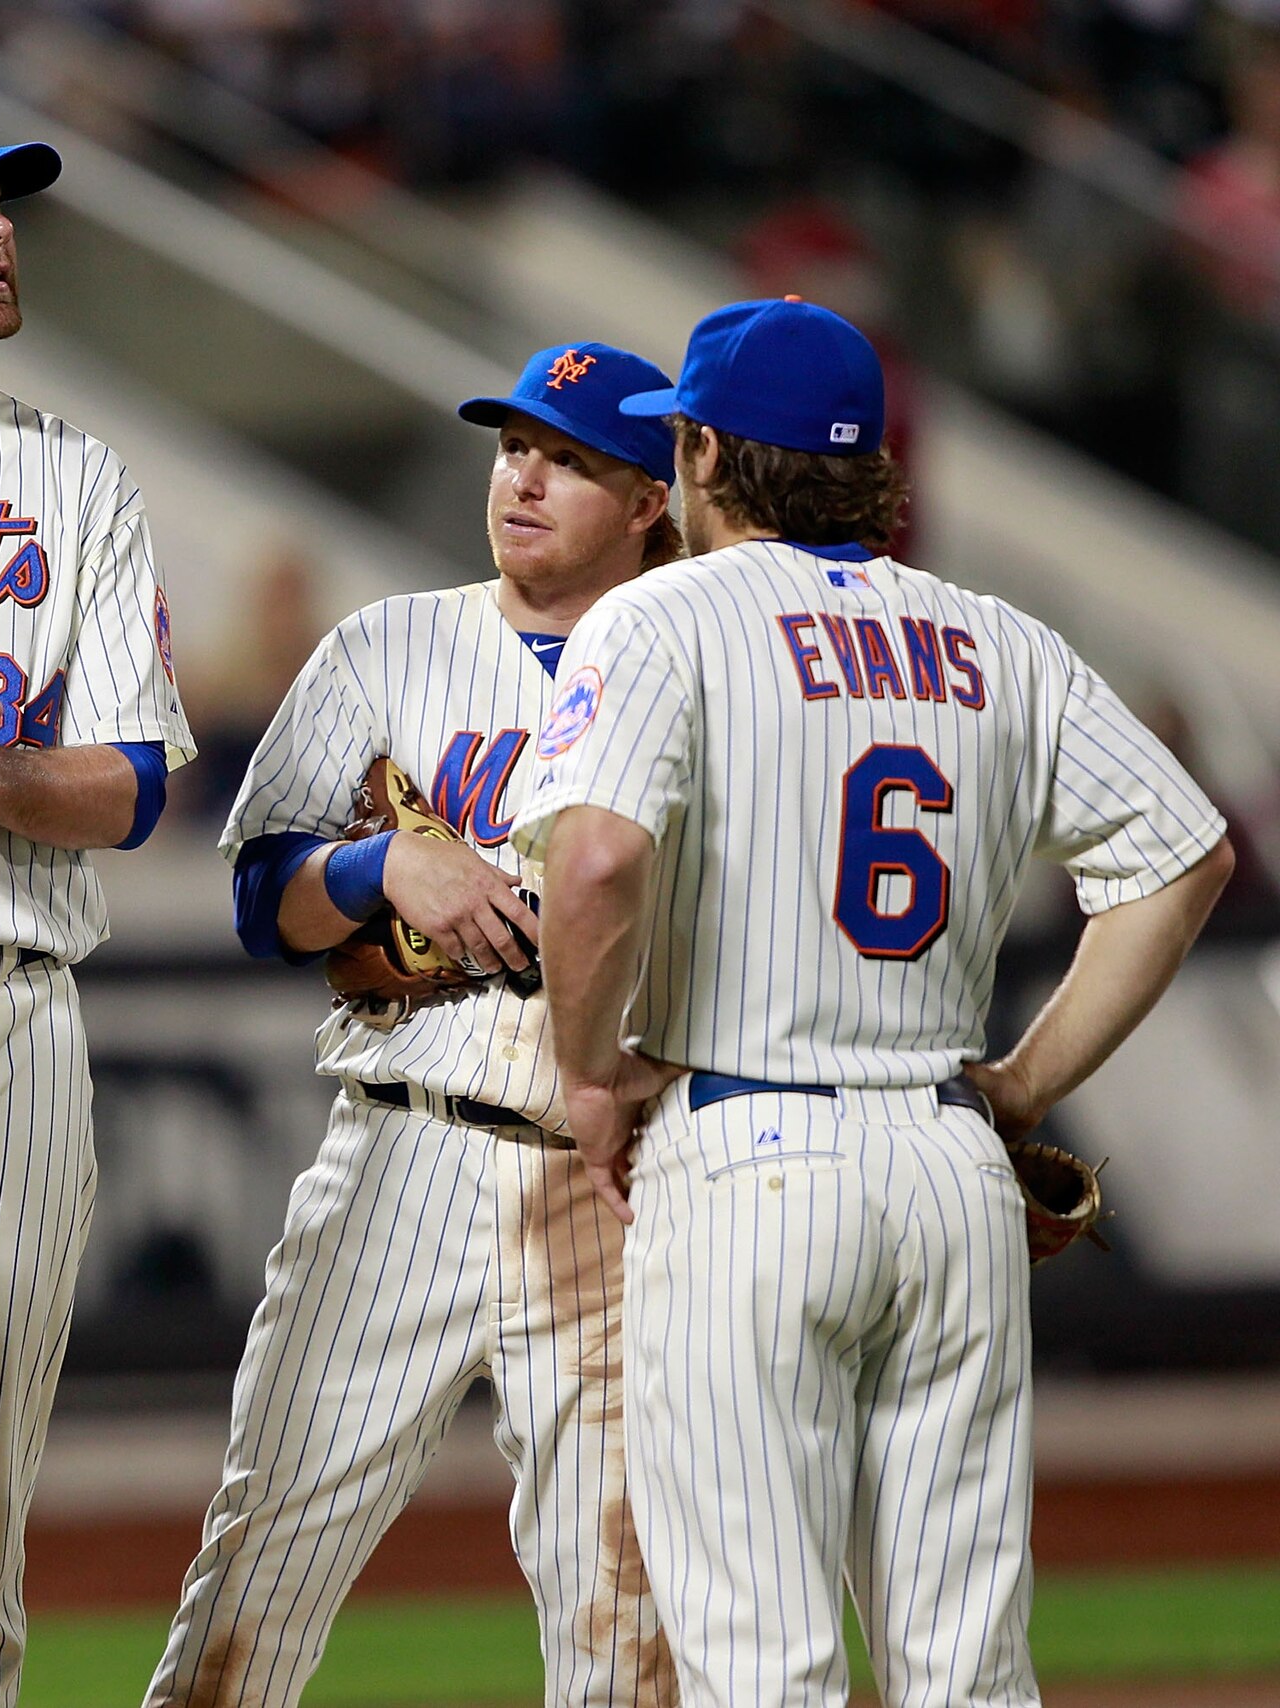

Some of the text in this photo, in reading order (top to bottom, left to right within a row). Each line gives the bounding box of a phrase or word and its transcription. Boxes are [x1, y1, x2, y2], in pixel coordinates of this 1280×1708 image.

[546, 349, 596, 389] NY
[776, 611, 986, 711] EVANS
[832, 742, 953, 961] 6
